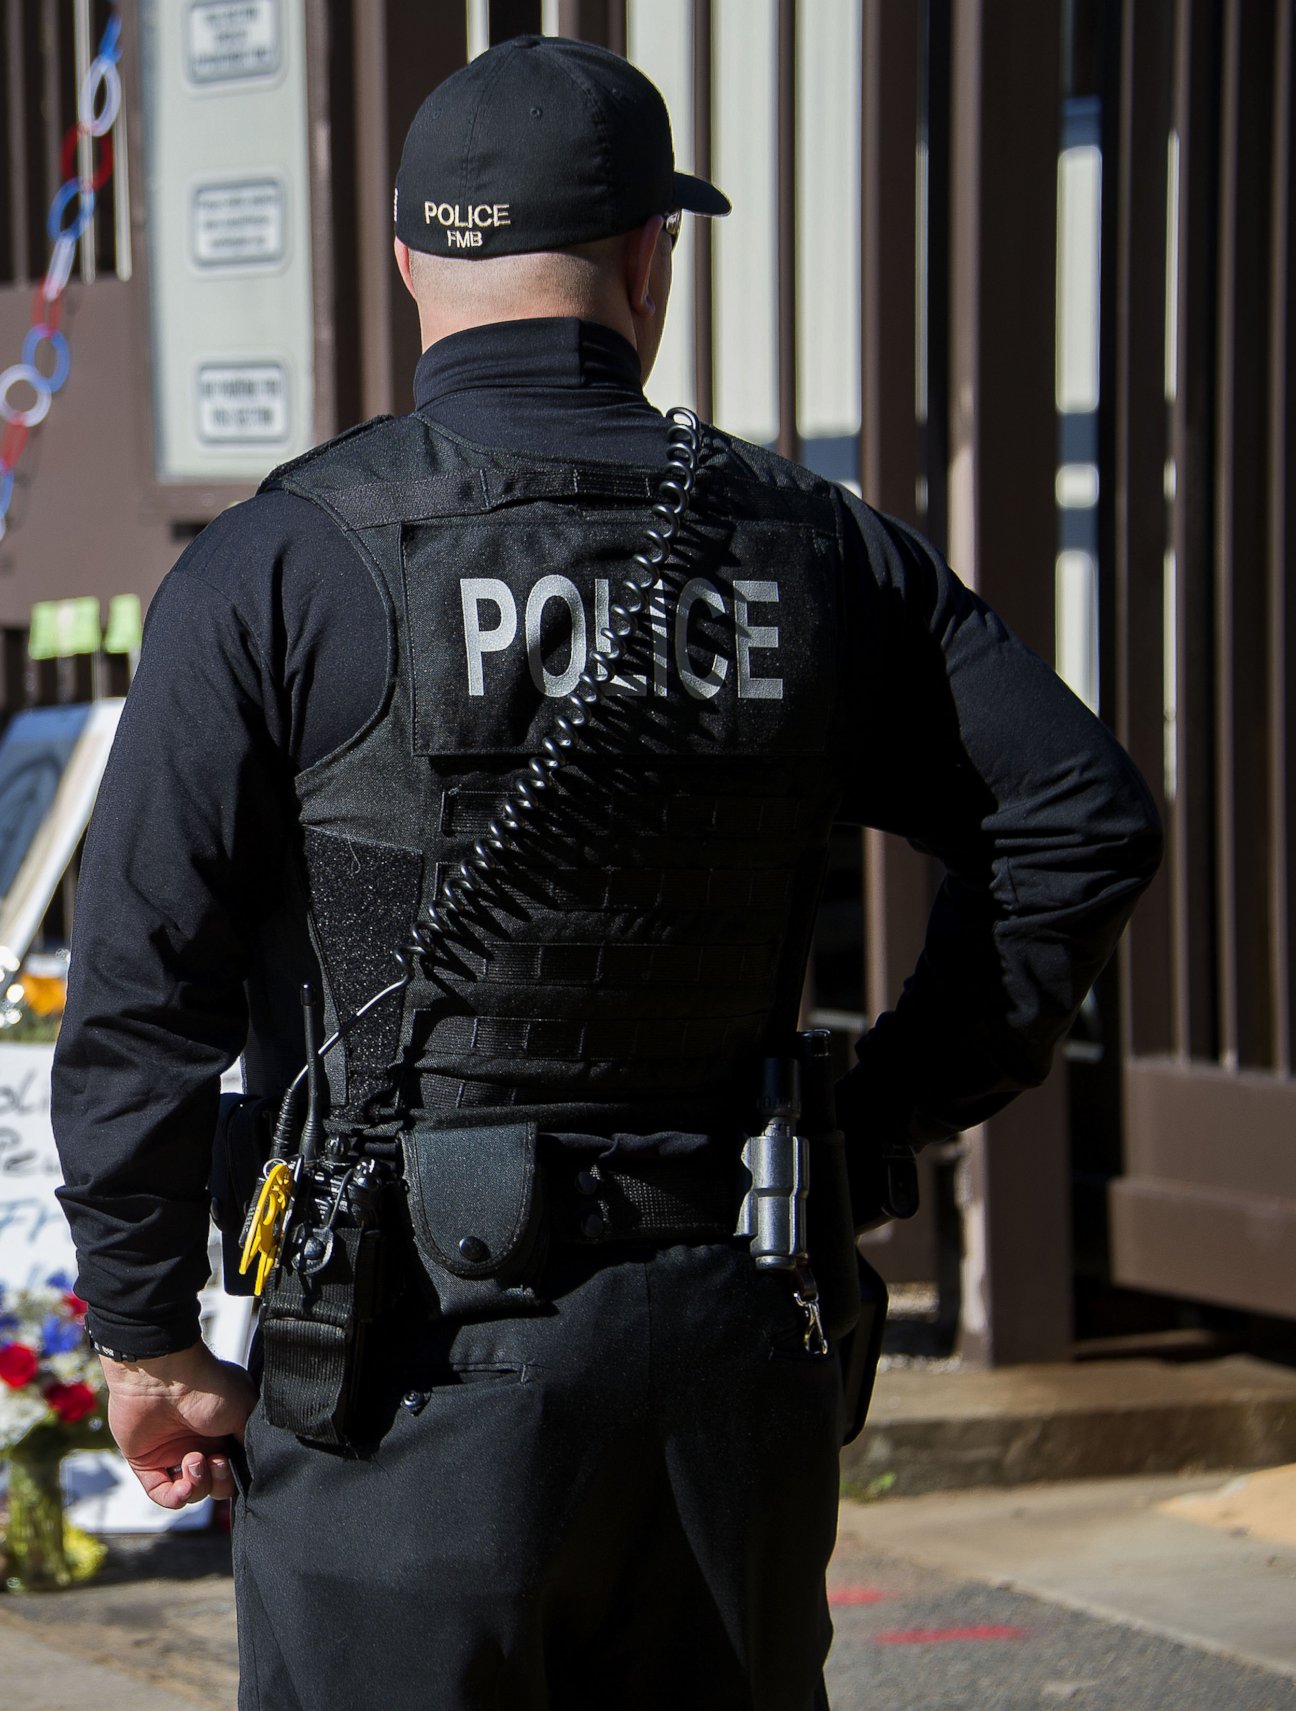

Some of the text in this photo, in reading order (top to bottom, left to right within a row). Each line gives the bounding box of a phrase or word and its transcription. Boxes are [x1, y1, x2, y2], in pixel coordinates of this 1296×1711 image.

[424, 201, 511, 228] POLICE
[447, 230, 483, 248] FMB
[460, 574, 784, 700] POLICE
